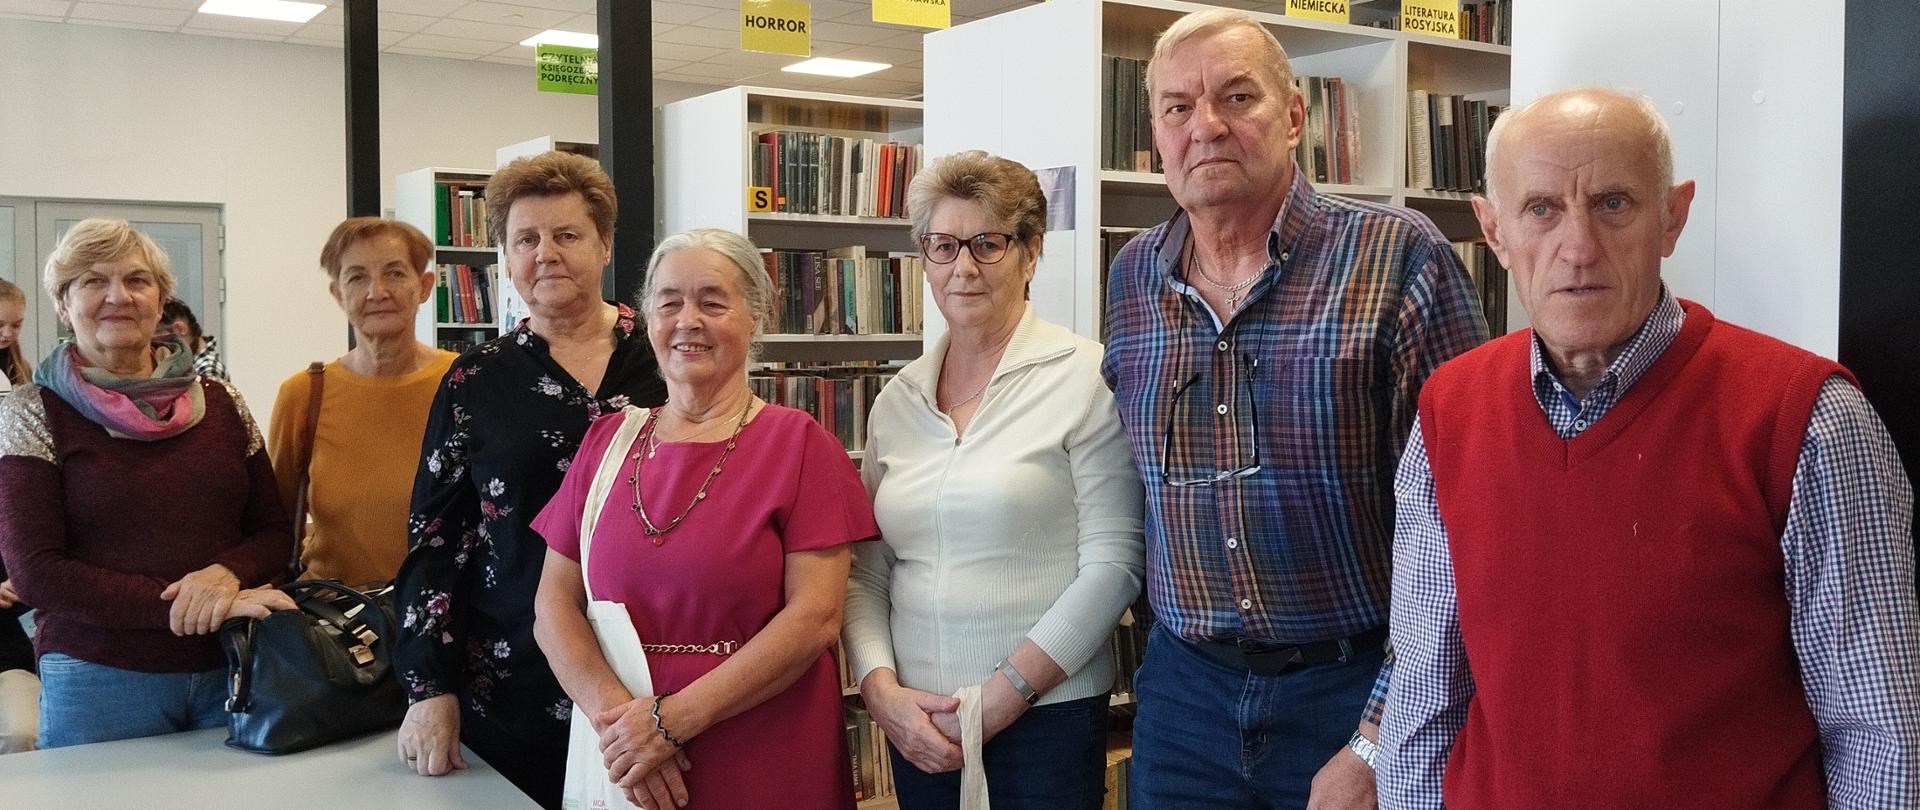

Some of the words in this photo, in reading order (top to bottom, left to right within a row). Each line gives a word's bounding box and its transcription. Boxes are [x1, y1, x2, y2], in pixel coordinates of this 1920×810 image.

[1290, 0, 1346, 15] NIEMIECKA
[1405, 5, 1455, 22] LITERATURA
[745, 15, 807, 34] HORROR
[1405, 18, 1455, 35] ROSYJSKA
[541, 73, 599, 86] PODRĘCZNY
[755, 190, 768, 208] S
